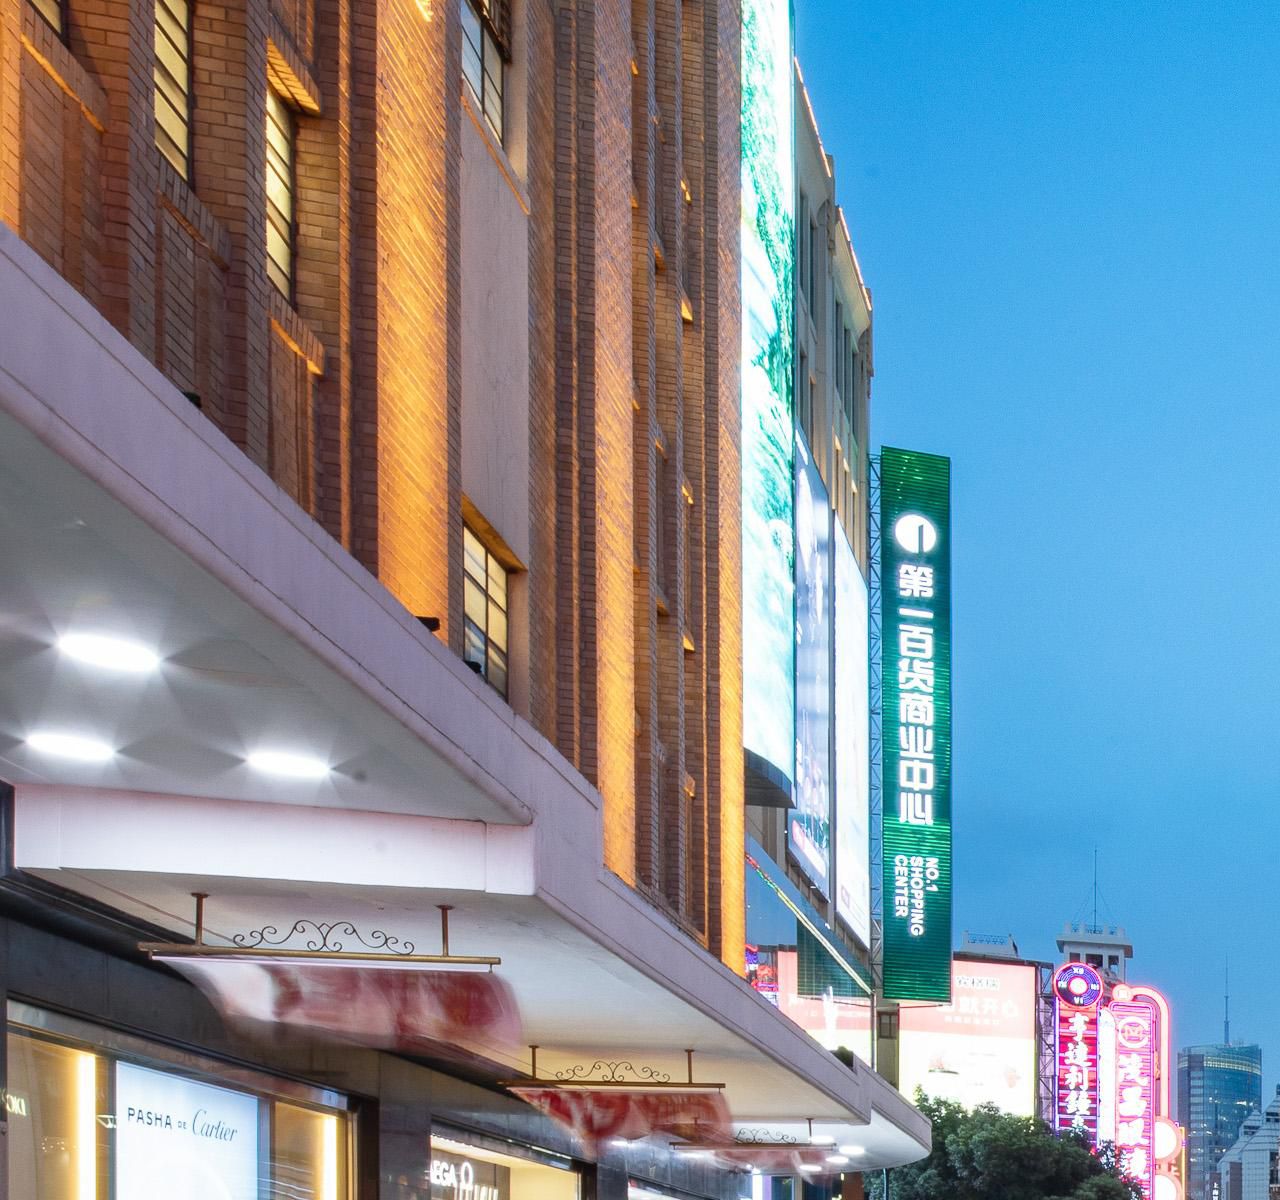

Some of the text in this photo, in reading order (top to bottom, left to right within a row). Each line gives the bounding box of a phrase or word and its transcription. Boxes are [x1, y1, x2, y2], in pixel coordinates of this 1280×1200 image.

[899, 563, 934, 825] 第一百货商业中心
[894, 854, 908, 917] CENTER
[910, 856, 924, 936] SHOPPING
[925, 857, 939, 892] NO.1
[127, 1106, 173, 1130] PASHA
[192, 1108, 238, 1143] Cartier
[430, 1159, 457, 1189] EGA
